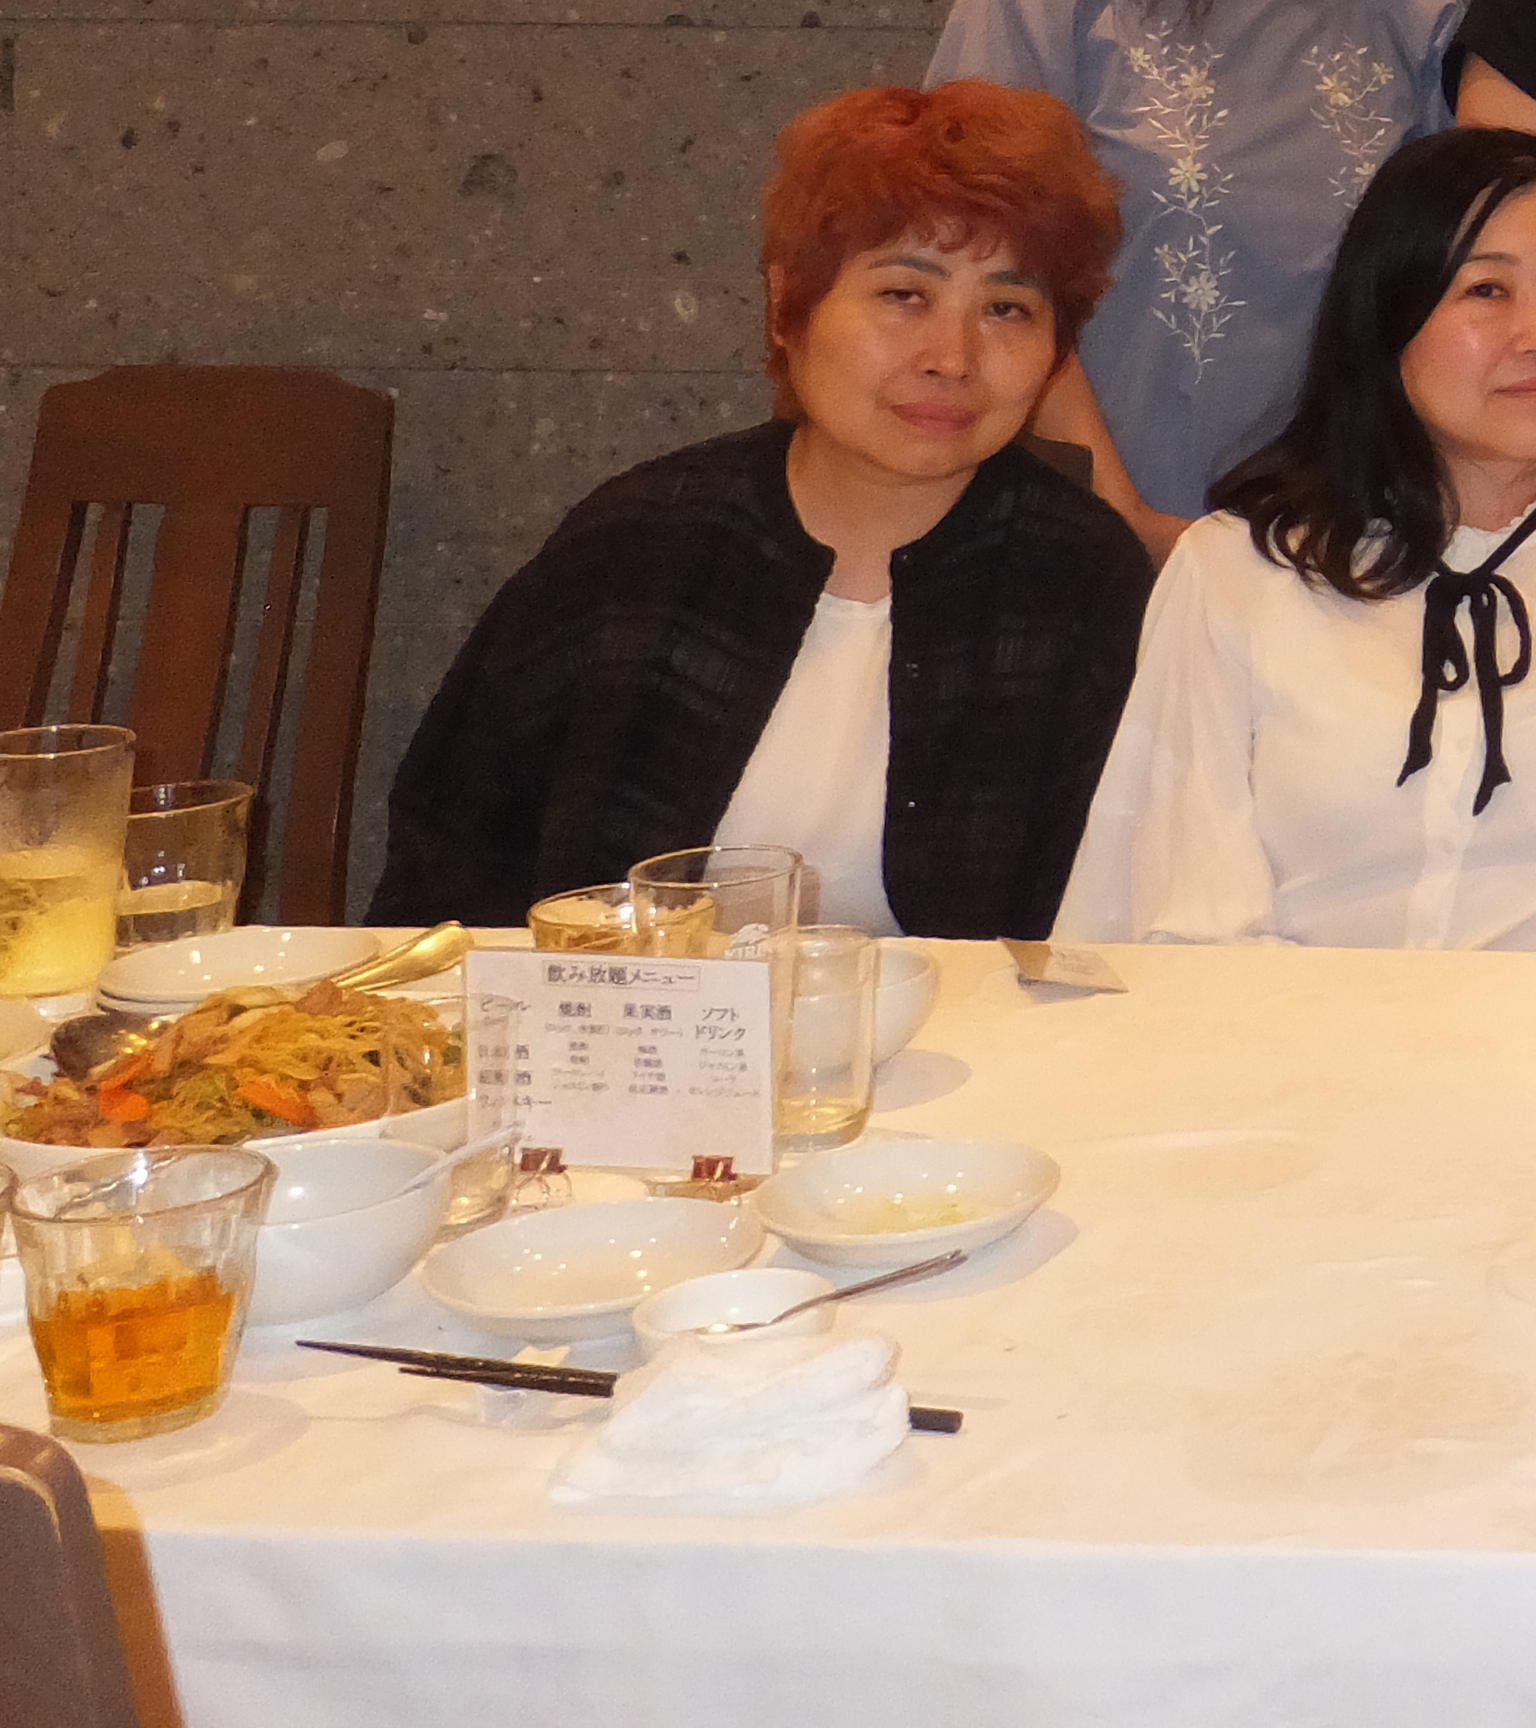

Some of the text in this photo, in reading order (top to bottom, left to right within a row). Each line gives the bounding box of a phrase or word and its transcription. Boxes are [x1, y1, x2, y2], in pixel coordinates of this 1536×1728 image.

[547, 964, 695, 985] 飲み放題メニュー
[695, 1025, 746, 1041] ドリンク
